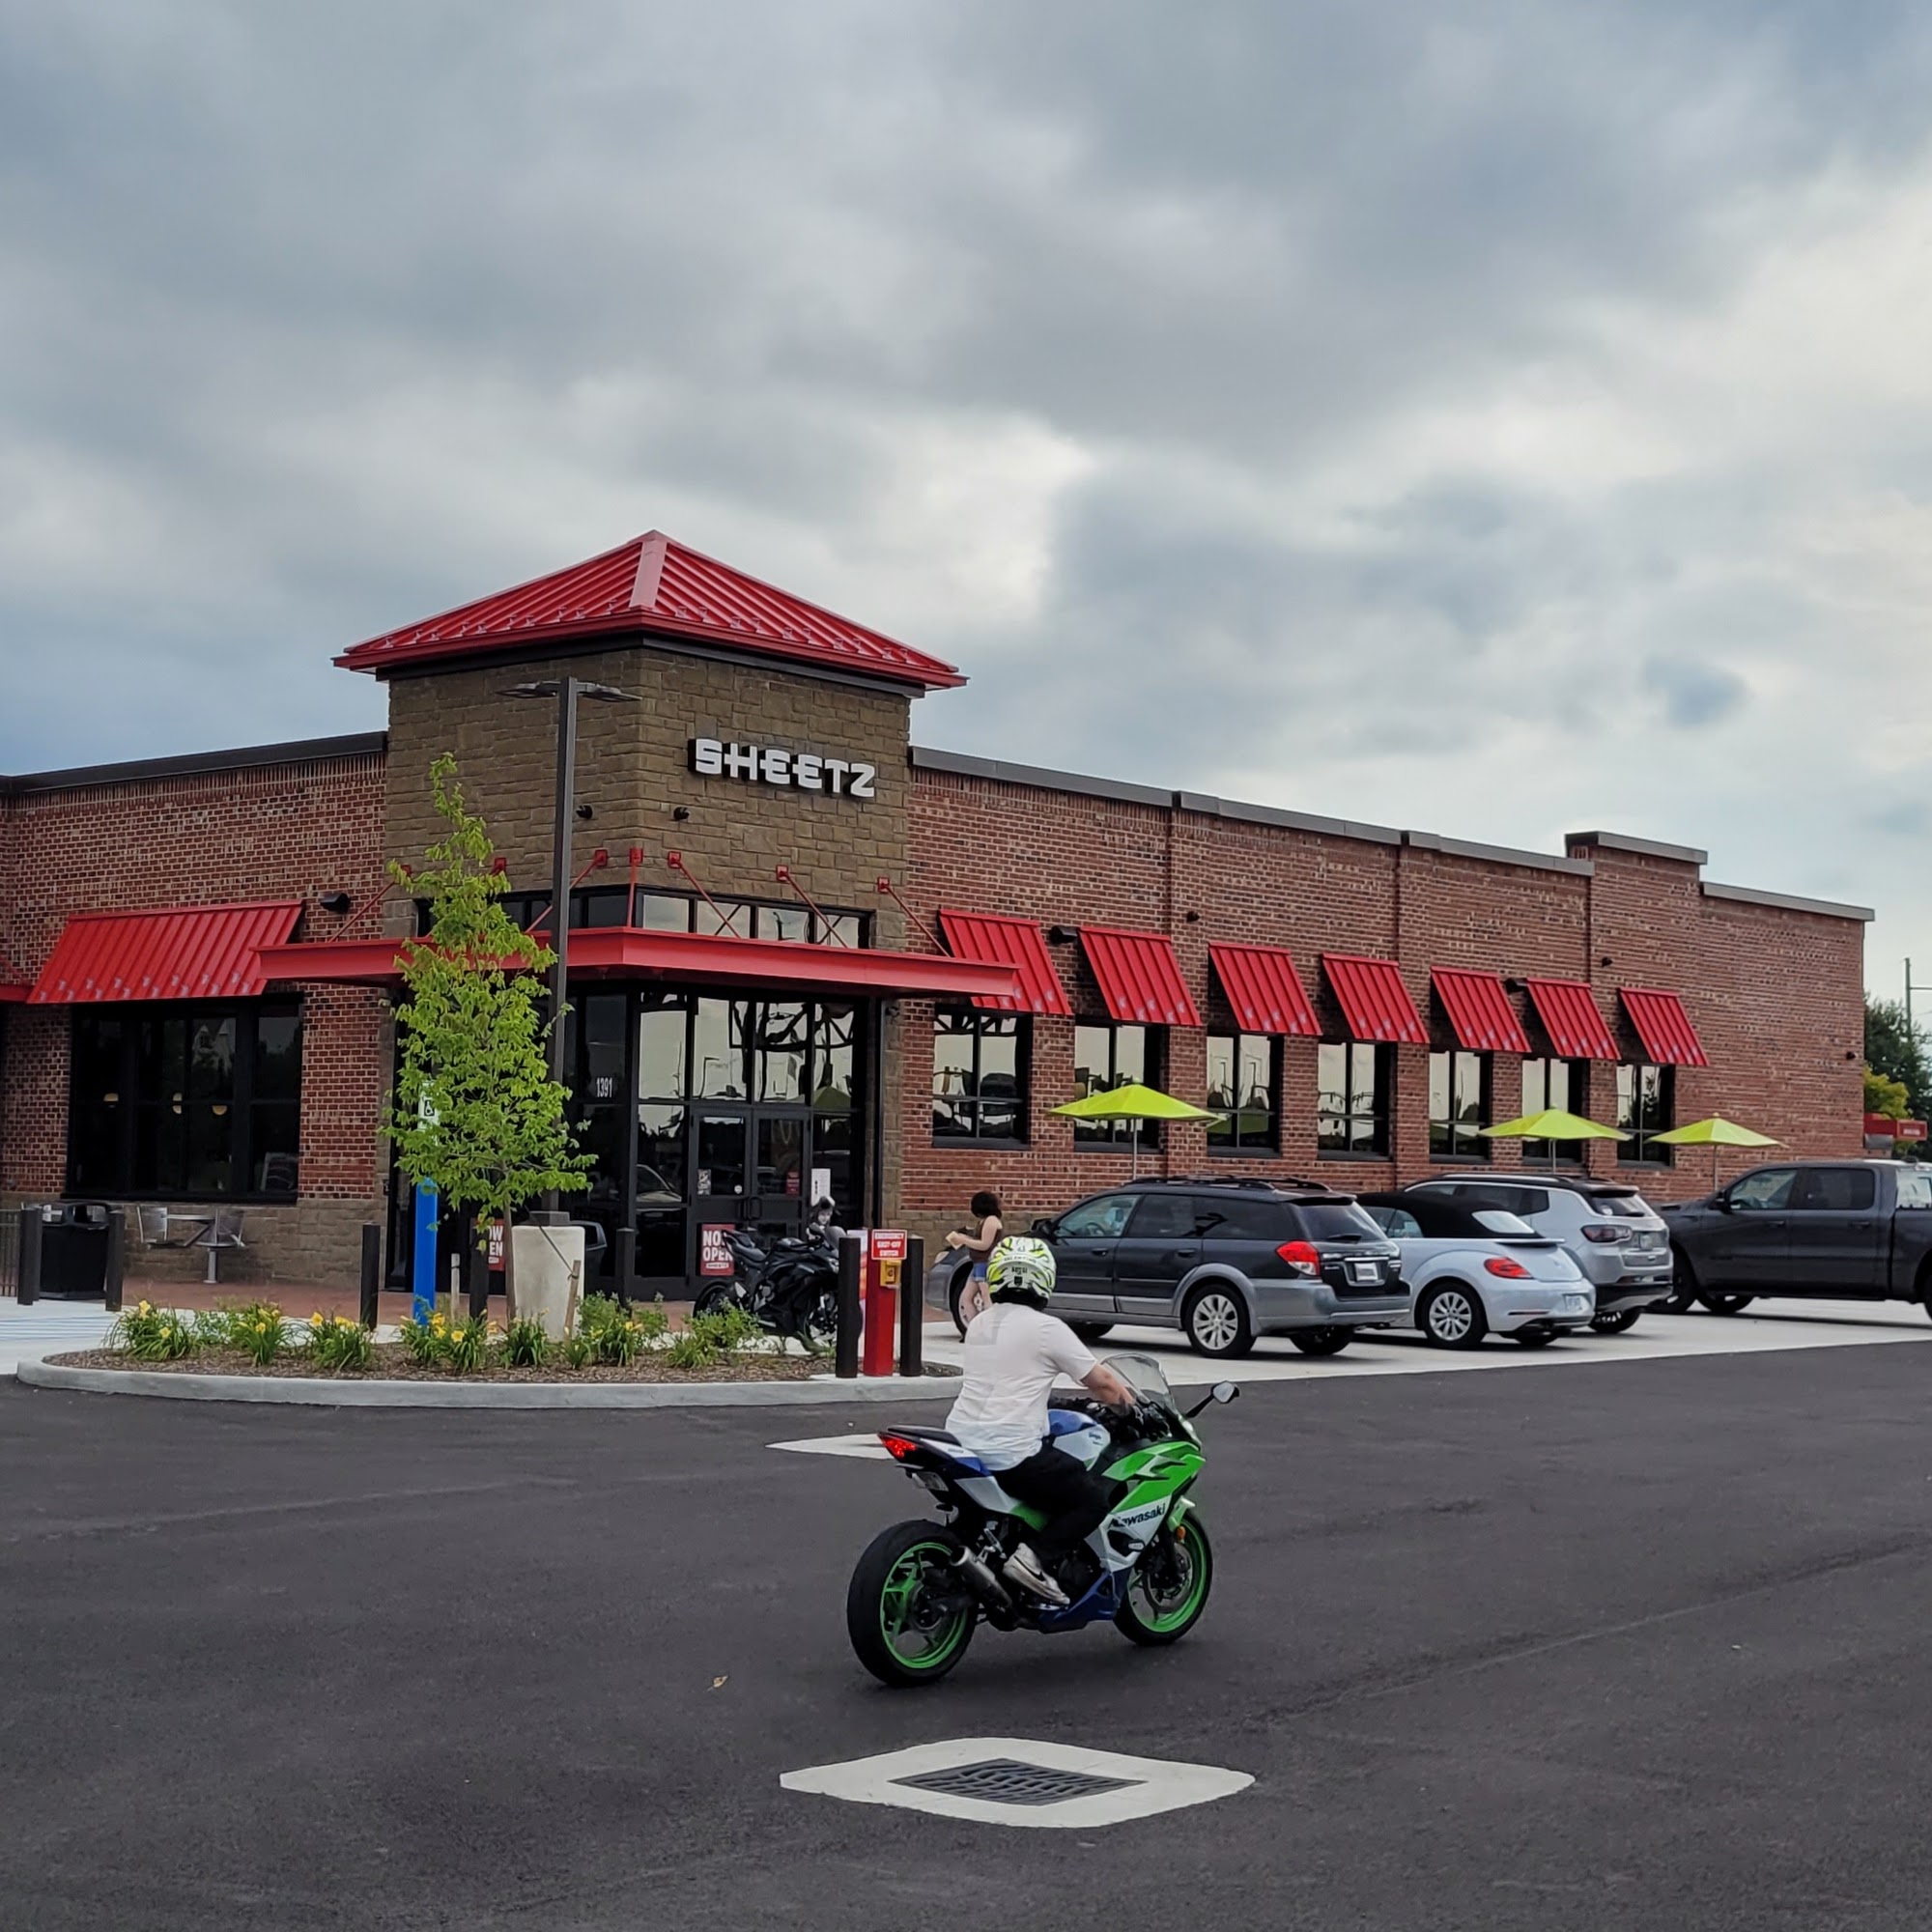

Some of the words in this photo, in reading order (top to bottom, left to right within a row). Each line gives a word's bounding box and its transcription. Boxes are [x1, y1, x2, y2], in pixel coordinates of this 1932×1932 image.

[695, 738, 876, 798] SHEETZ
[596, 1077, 613, 1097] 1391
[489, 1241, 503, 1256] EN
[702, 1246, 733, 1262] OPEN
